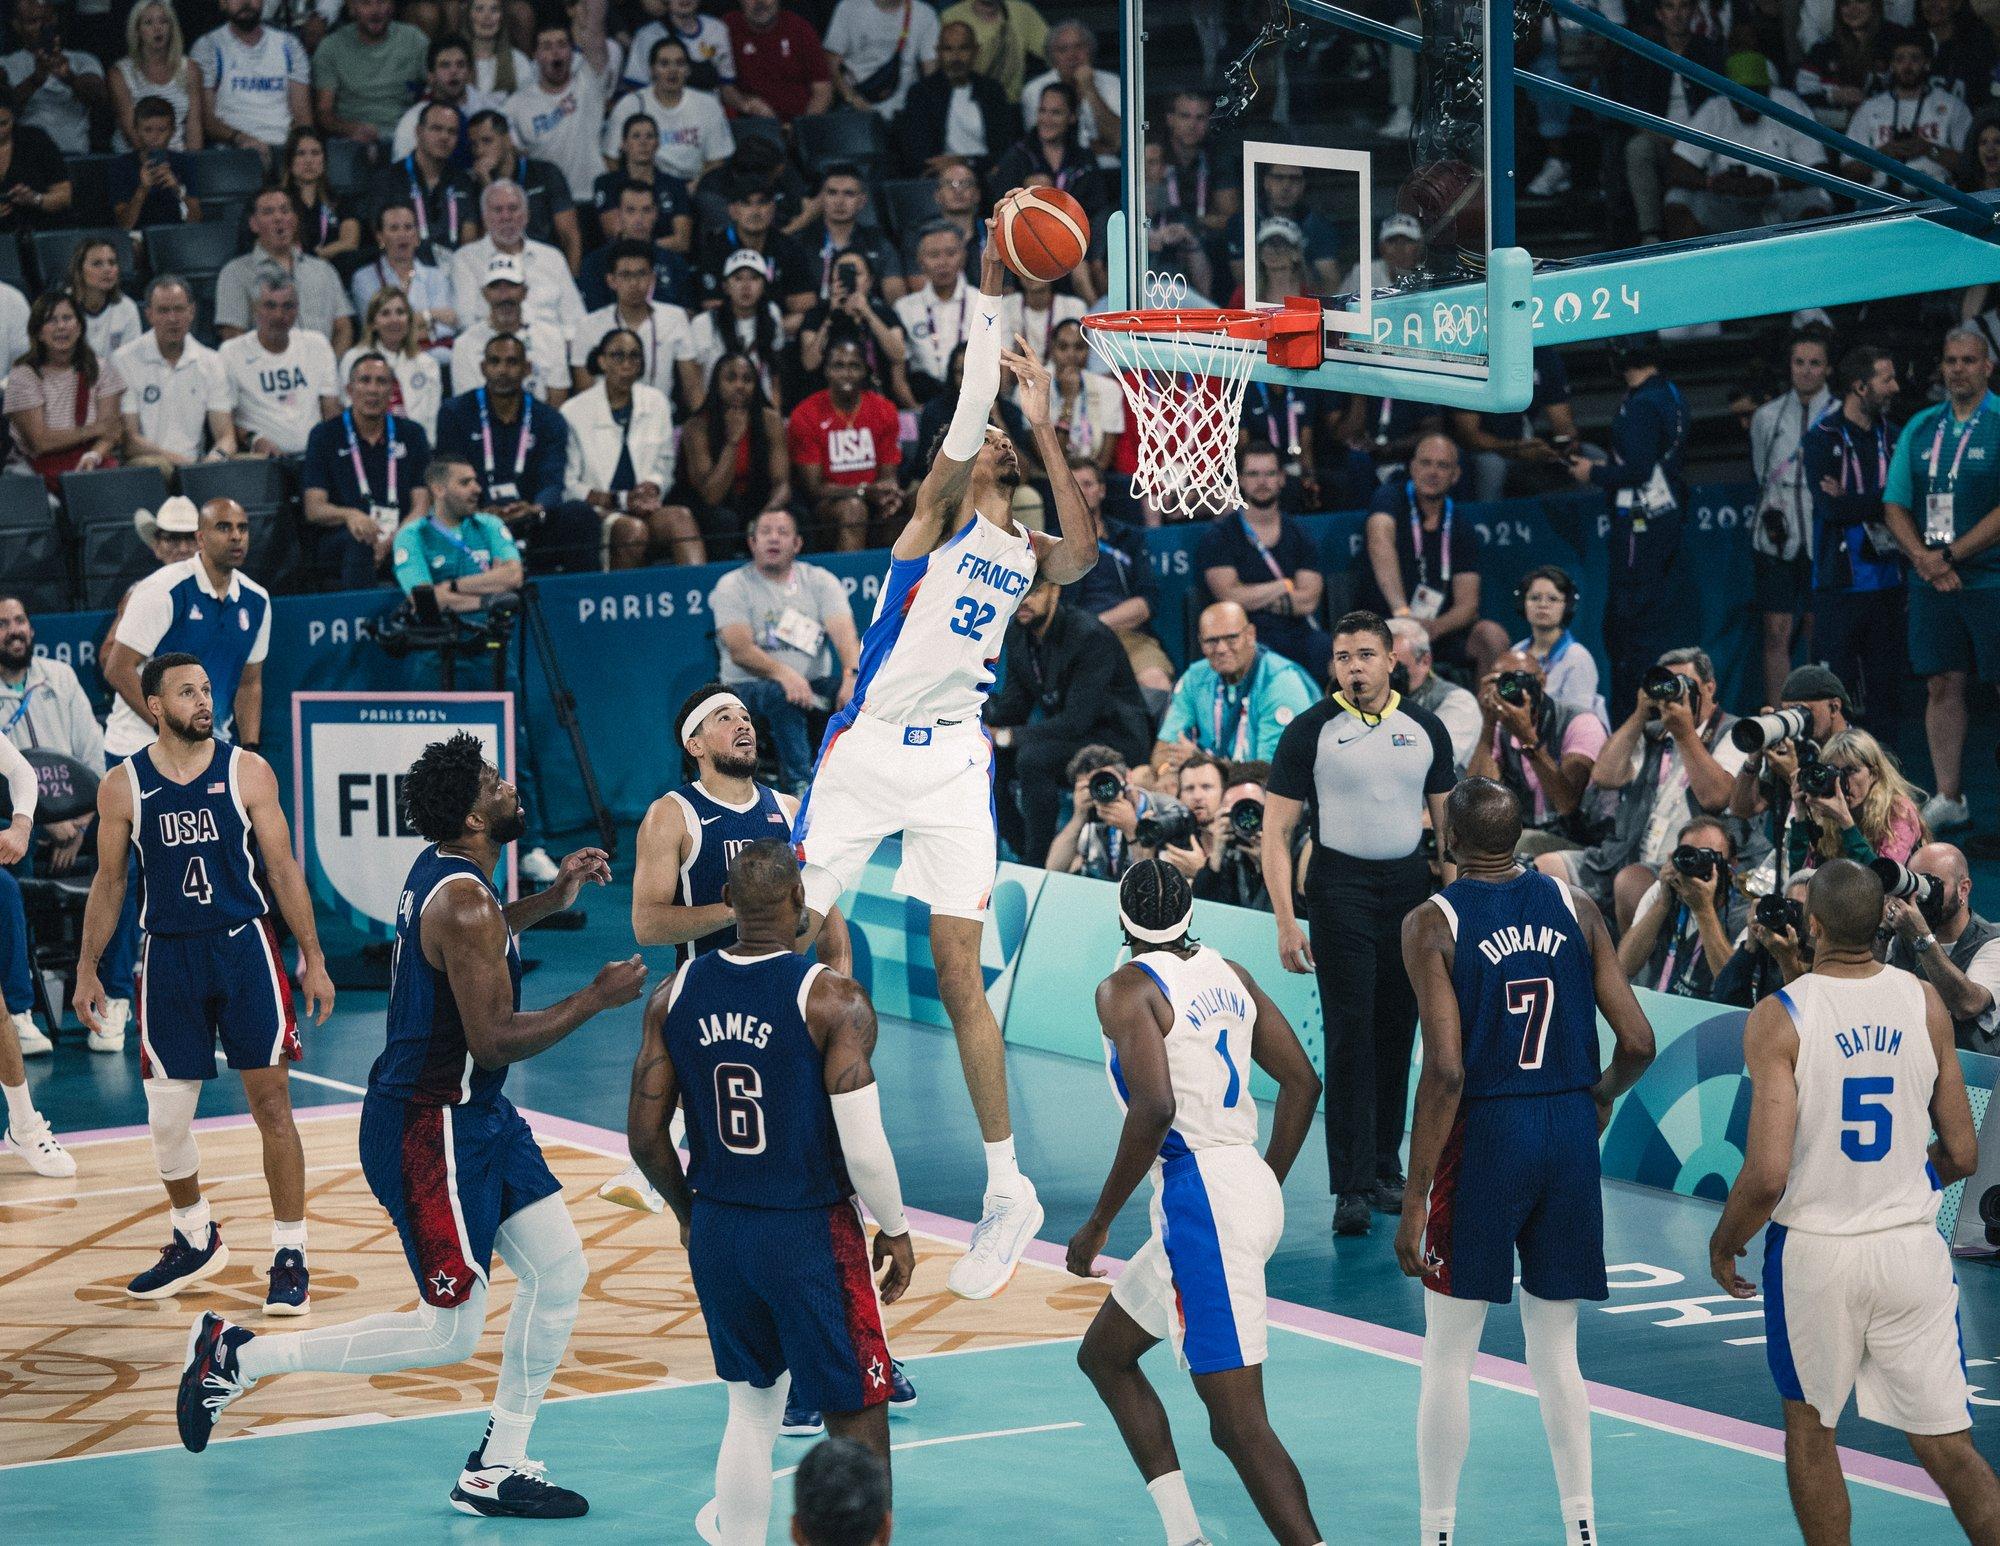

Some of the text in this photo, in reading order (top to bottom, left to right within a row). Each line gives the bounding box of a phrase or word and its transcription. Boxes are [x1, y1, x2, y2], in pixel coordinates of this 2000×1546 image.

[259, 366, 309, 393] USA
[828, 427, 877, 463] USA
[578, 591, 674, 623] PARIS
[949, 595, 997, 642] 32
[360, 709, 447, 721] PARIS 2024
[159, 808, 220, 847] USA
[182, 856, 213, 905] 4
[1478, 924, 1568, 966] DURANT
[1186, 987, 1246, 1032] NTILIKINA
[1505, 977, 1555, 1070] 7
[698, 1012, 773, 1050] JAMES
[1835, 1025, 1903, 1059] BATUM
[1214, 1028, 1240, 1108] 1
[713, 1062, 767, 1155] 6
[1840, 1076, 1894, 1162] 5
